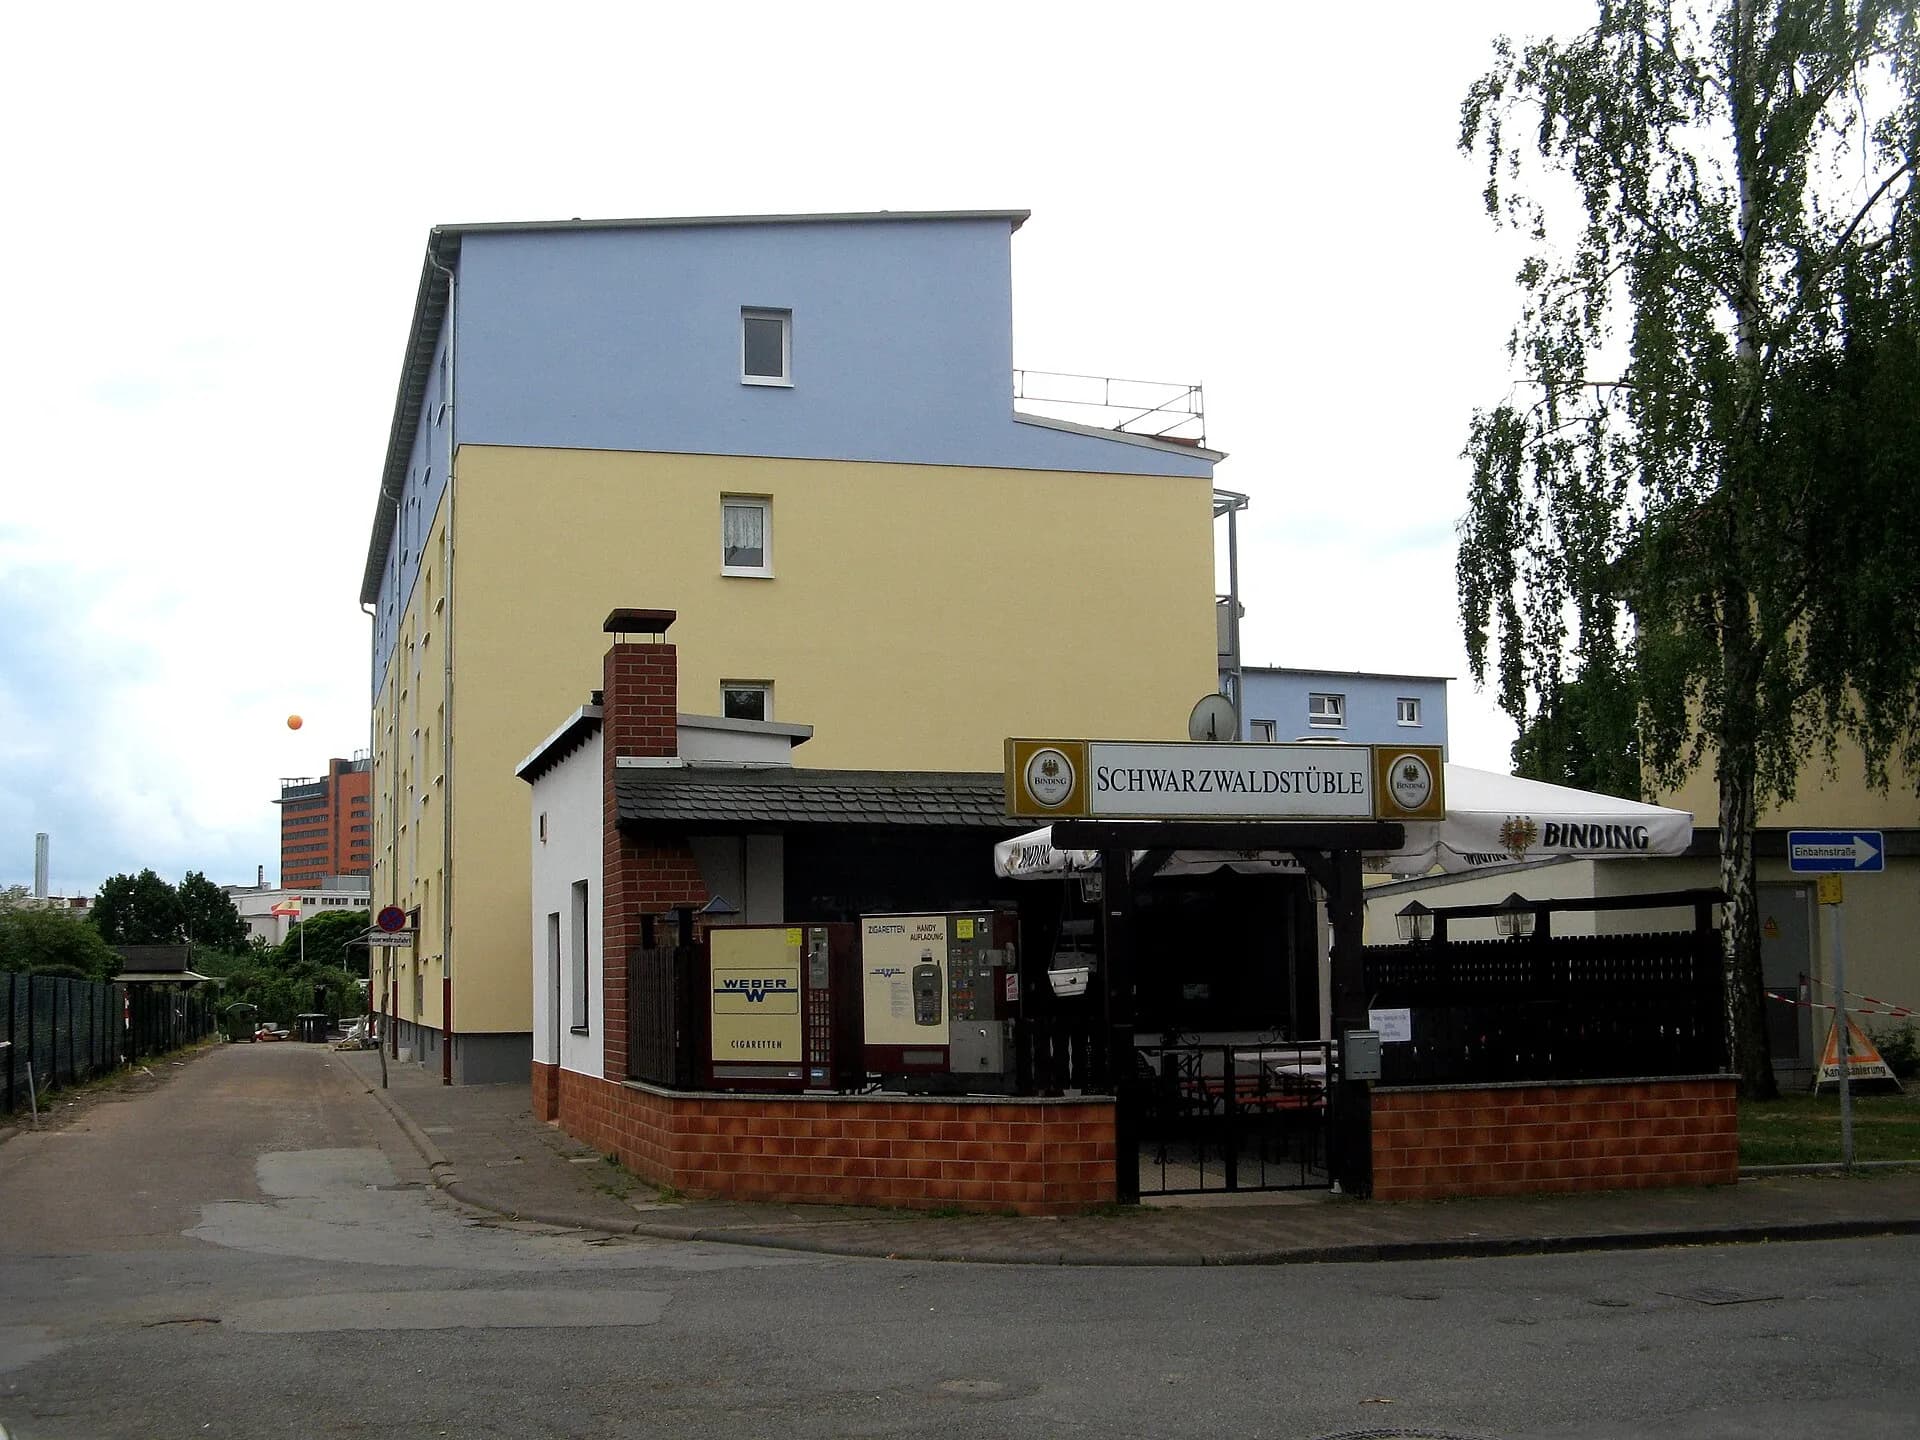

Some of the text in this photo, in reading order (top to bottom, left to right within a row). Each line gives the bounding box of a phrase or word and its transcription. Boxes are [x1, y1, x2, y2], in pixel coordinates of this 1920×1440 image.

[1034, 777, 1067, 785] BINDING
[1097, 766, 1364, 794] SCHWARZWALDSTÜBLE
[1543, 822, 1649, 849] BINDING
[1794, 847, 1857, 857] Einbahnstraße
[916, 924, 937, 932] HANDY
[723, 979, 787, 989] WEBER
[730, 1040, 782, 1049] CIGARETTEN
